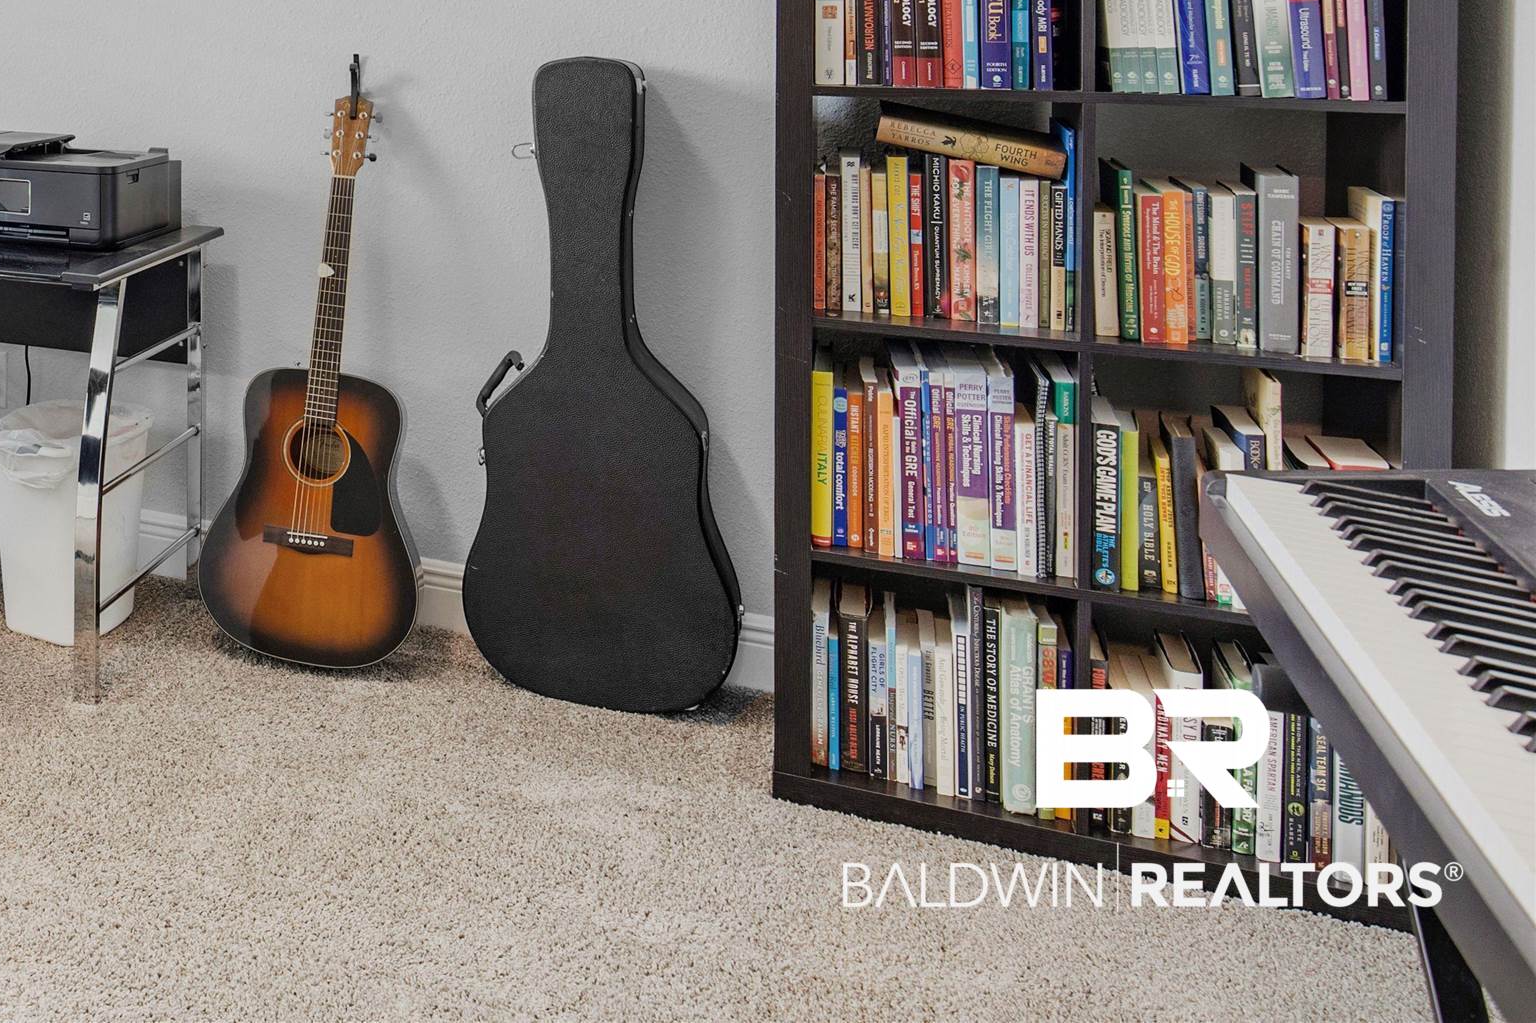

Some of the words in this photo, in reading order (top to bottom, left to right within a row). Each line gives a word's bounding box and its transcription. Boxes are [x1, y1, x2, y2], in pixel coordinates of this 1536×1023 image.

[987, 16, 1000, 41] Book
[1038, 16, 1048, 32] MRI
[1299, 7, 1312, 49] Ultrasound
[890, 120, 937, 137] REBECCA
[994, 143, 1038, 160] FOURTH
[1000, 153, 1029, 167] WING
[912, 184, 920, 196] THE
[963, 181, 971, 198] THE
[984, 180, 992, 198] THE
[1025, 189, 1034, 198] IT
[830, 196, 838, 219] FAMILY
[912, 197, 920, 216] SHIFT
[933, 193, 941, 220] KAKU
[984, 200, 993, 232] FLIGHT
[1024, 199, 1035, 222] ENDS
[1054, 191, 1064, 220] GIFTED
[1152, 202, 1160, 215] The
[1196, 191, 1205, 224] CONFESSIONS
[952, 197, 961, 249] EVERYTHING
[963, 200, 972, 243] ANTIDOTE
[1024, 222, 1035, 244] WITH
[1152, 216, 1160, 235] Mind
[1164, 211, 1181, 244] HOUSE
[1271, 220, 1282, 247] CHAIN
[1382, 213, 1392, 240] PROOF
[1054, 221, 1064, 250] HANDS
[1024, 246, 1035, 257] US
[1153, 241, 1161, 255] The
[1271, 249, 1282, 259] OF
[1153, 256, 1161, 274] Brain
[1164, 255, 1181, 276] GOD
[1381, 249, 1392, 282] HEAVEN
[1271, 261, 1282, 305] COMMAND
[1309, 297, 1321, 347] OPTION
[956, 393, 986, 401] POTTER
[959, 384, 983, 392] PERRY
[931, 388, 941, 414] Official
[946, 391, 955, 415] Official
[850, 404, 859, 433] INSTANT
[904, 399, 917, 440] Official
[931, 415, 941, 430] GRE
[946, 417, 955, 430] GRE
[961, 414, 972, 435] Skills
[972, 414, 982, 444] Clinical
[994, 415, 1003, 440] Clinical
[994, 440, 1003, 465] Nursing
[1025, 433, 1033, 450] GET
[1096, 429, 1117, 466] GOD'S
[1250, 440, 1261, 464] BOOK
[816, 452, 828, 486] ITALY
[835, 451, 845, 473] total
[905, 454, 917, 477] GRE
[961, 444, 972, 487] Techniques
[970, 444, 983, 475] Nursing
[995, 466, 1003, 484] Skills
[1025, 460, 1033, 505] FINANCIAL
[1096, 466, 1117, 503] GAME
[835, 474, 845, 510] comfort
[907, 481, 915, 504] General
[995, 491, 1004, 527] Techniques
[1025, 506, 1033, 524] LIFE
[1096, 502, 1116, 534] PLAN
[1144, 504, 1153, 528] HOLY
[1144, 531, 1154, 561] BIBLE
[848, 622, 857, 633] THE
[986, 619, 996, 640] THE
[815, 625, 825, 665] Bluebird
[847, 634, 858, 675] ALPHABET
[986, 643, 996, 675] STORY
[848, 678, 859, 704] HOUSE
[878, 677, 885, 688] OF
[987, 678, 996, 692] OF
[1009, 664, 1022, 695] Atlas
[923, 689, 935, 720] BETTER
[1010, 697, 1022, 711] of
[1022, 666, 1034, 724] GRANT'S
[986, 694, 997, 748] MEDICINE
[1008, 712, 1022, 767] Anatomy
[1267, 716, 1278, 756] AMERICAN
[1316, 735, 1327, 756] SEAL
[1157, 754, 1169, 773] MEN
[1267, 757, 1278, 791] SPARTAN
[1316, 756, 1327, 776] TEAM
[1316, 778, 1327, 792] SIX
